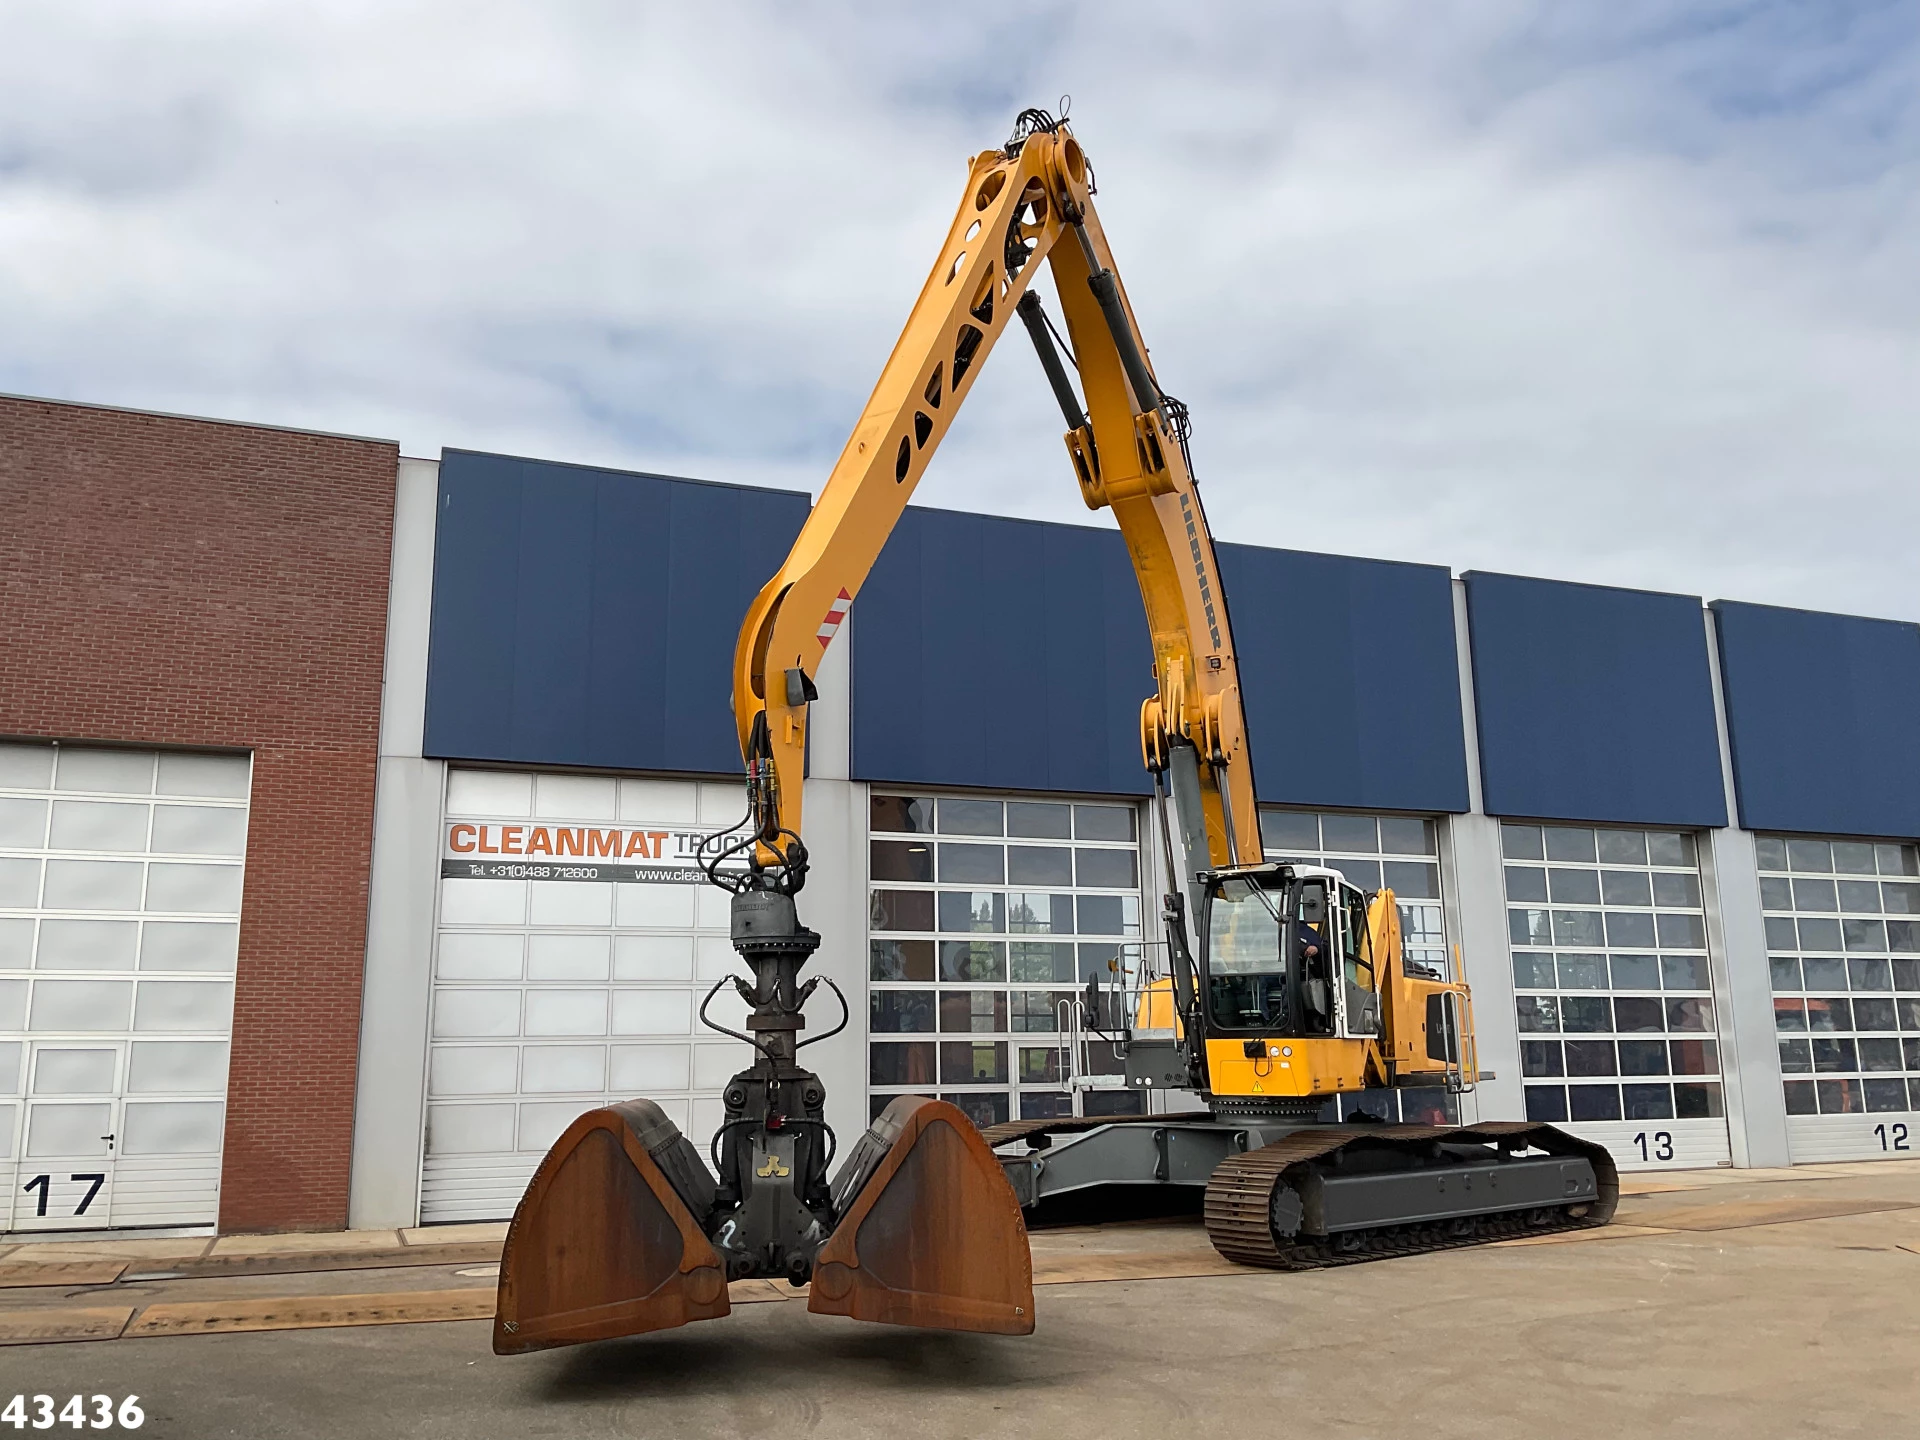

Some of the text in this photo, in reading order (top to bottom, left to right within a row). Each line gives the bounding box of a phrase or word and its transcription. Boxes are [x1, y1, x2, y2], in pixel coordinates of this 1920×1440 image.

[1180, 493, 1222, 653] LIEBHERR
[449, 823, 669, 859] CLEANMAT
[468, 864, 598, 879] Tel. +31(0)488 712600
[1633, 1131, 1674, 1162] 13
[1873, 1123, 1910, 1151] 12
[23, 1173, 106, 1217] 17
